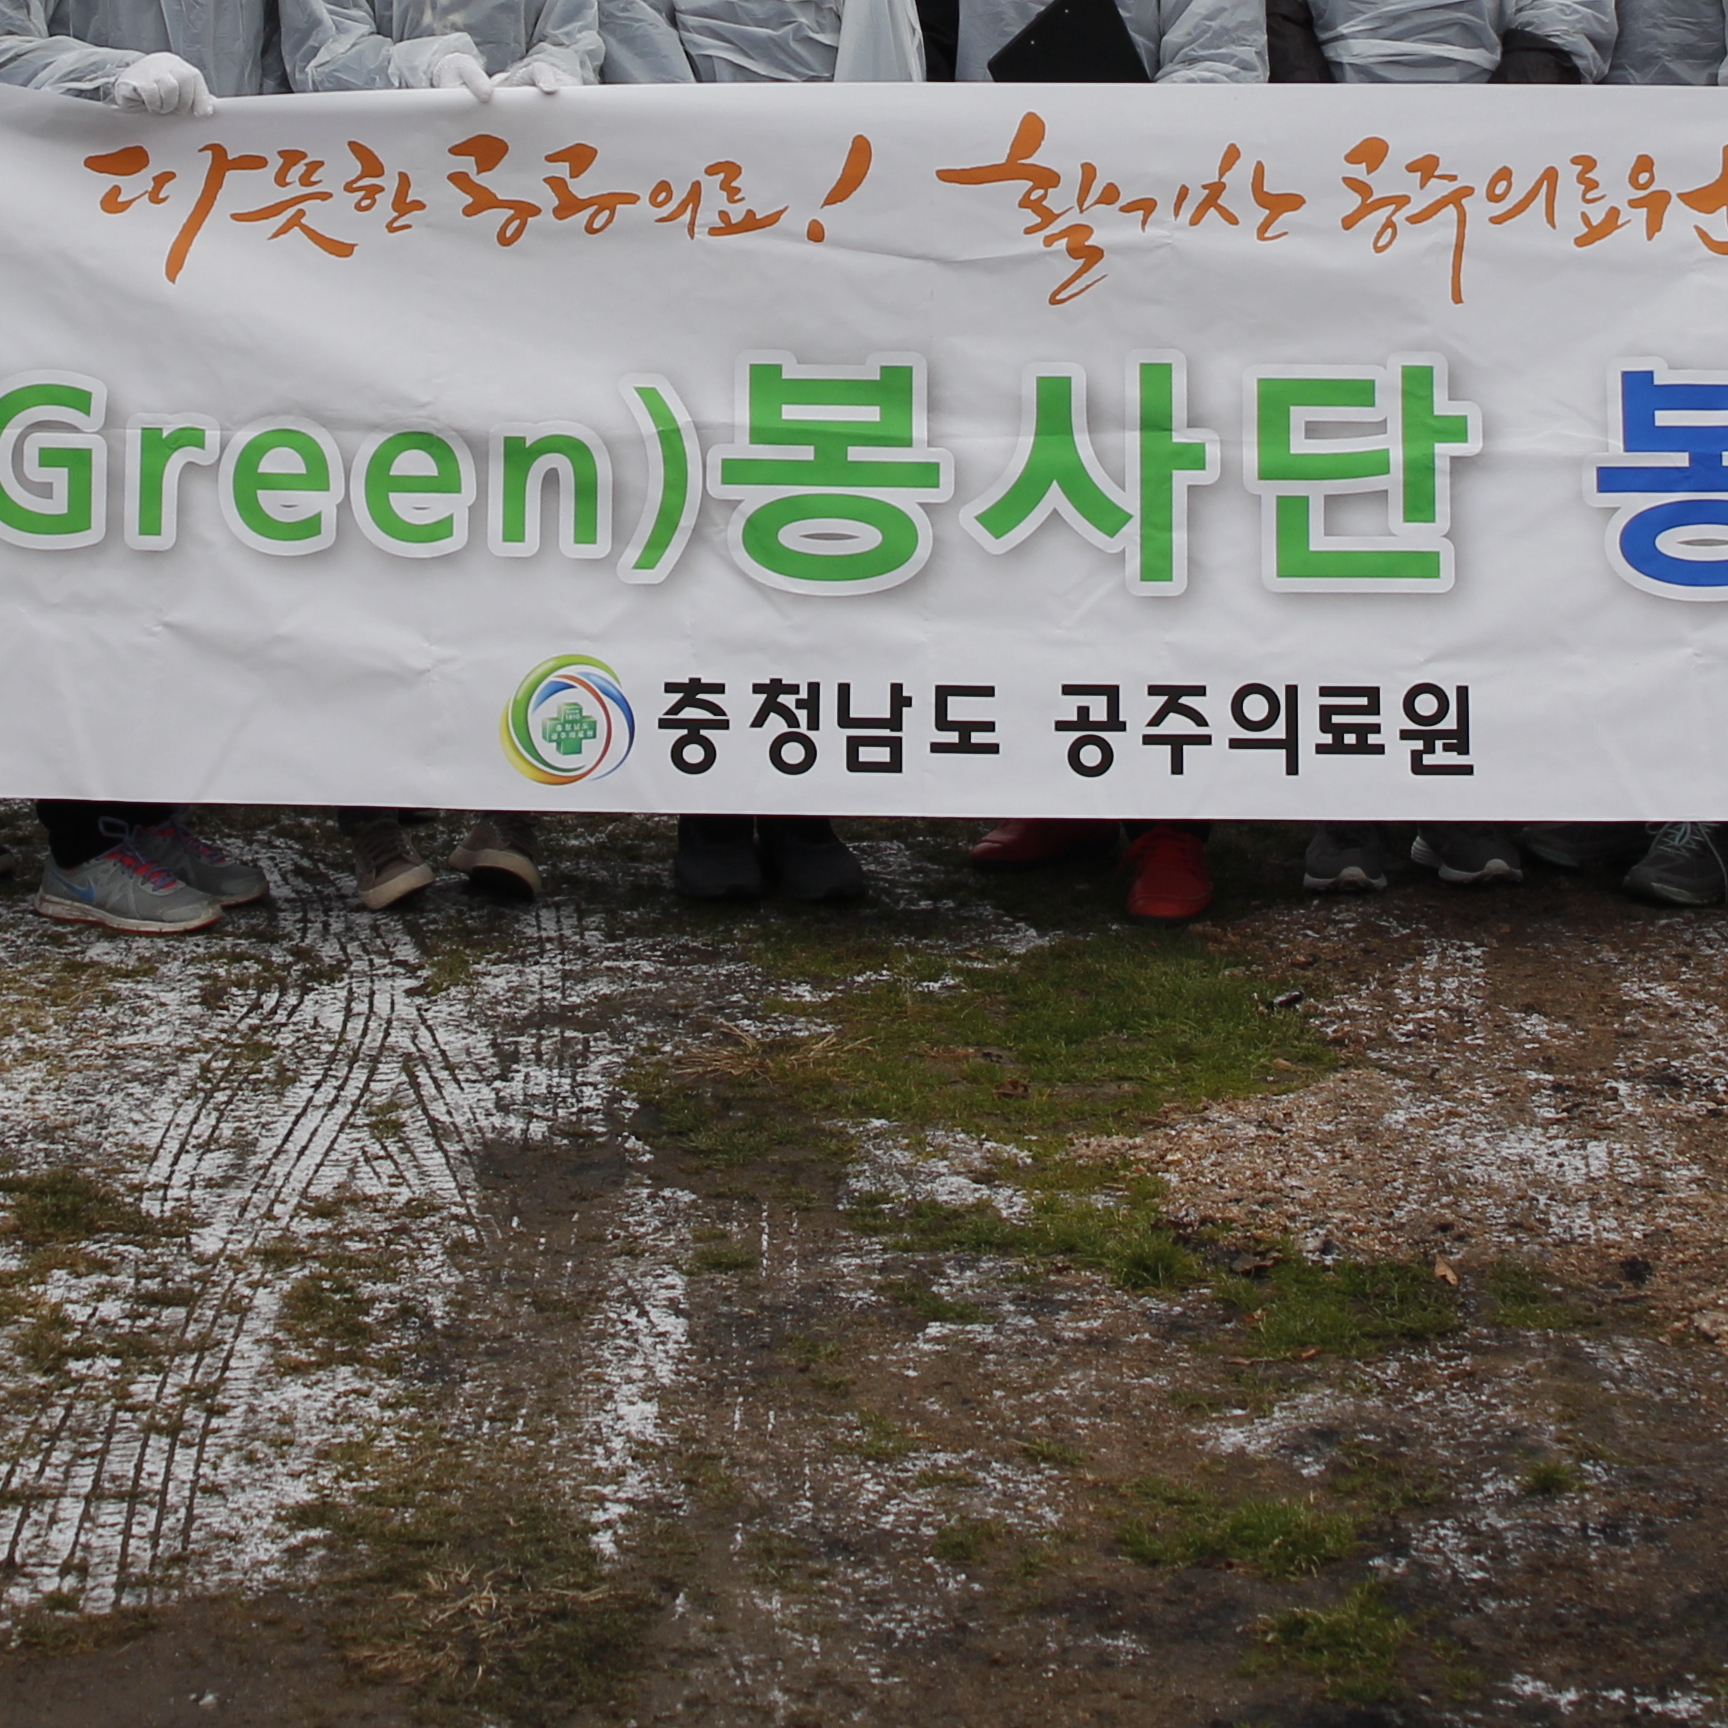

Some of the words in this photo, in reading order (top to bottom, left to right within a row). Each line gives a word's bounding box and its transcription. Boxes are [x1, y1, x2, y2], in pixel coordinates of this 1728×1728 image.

[85, 141, 426, 282] 따뜻한
[446, 134, 872, 247] 공공의료!
[934, 111, 1306, 305] 활기찬
[657, 677, 1000, 776] 충청남도
[1053, 682, 1474, 778] 공주의료원
